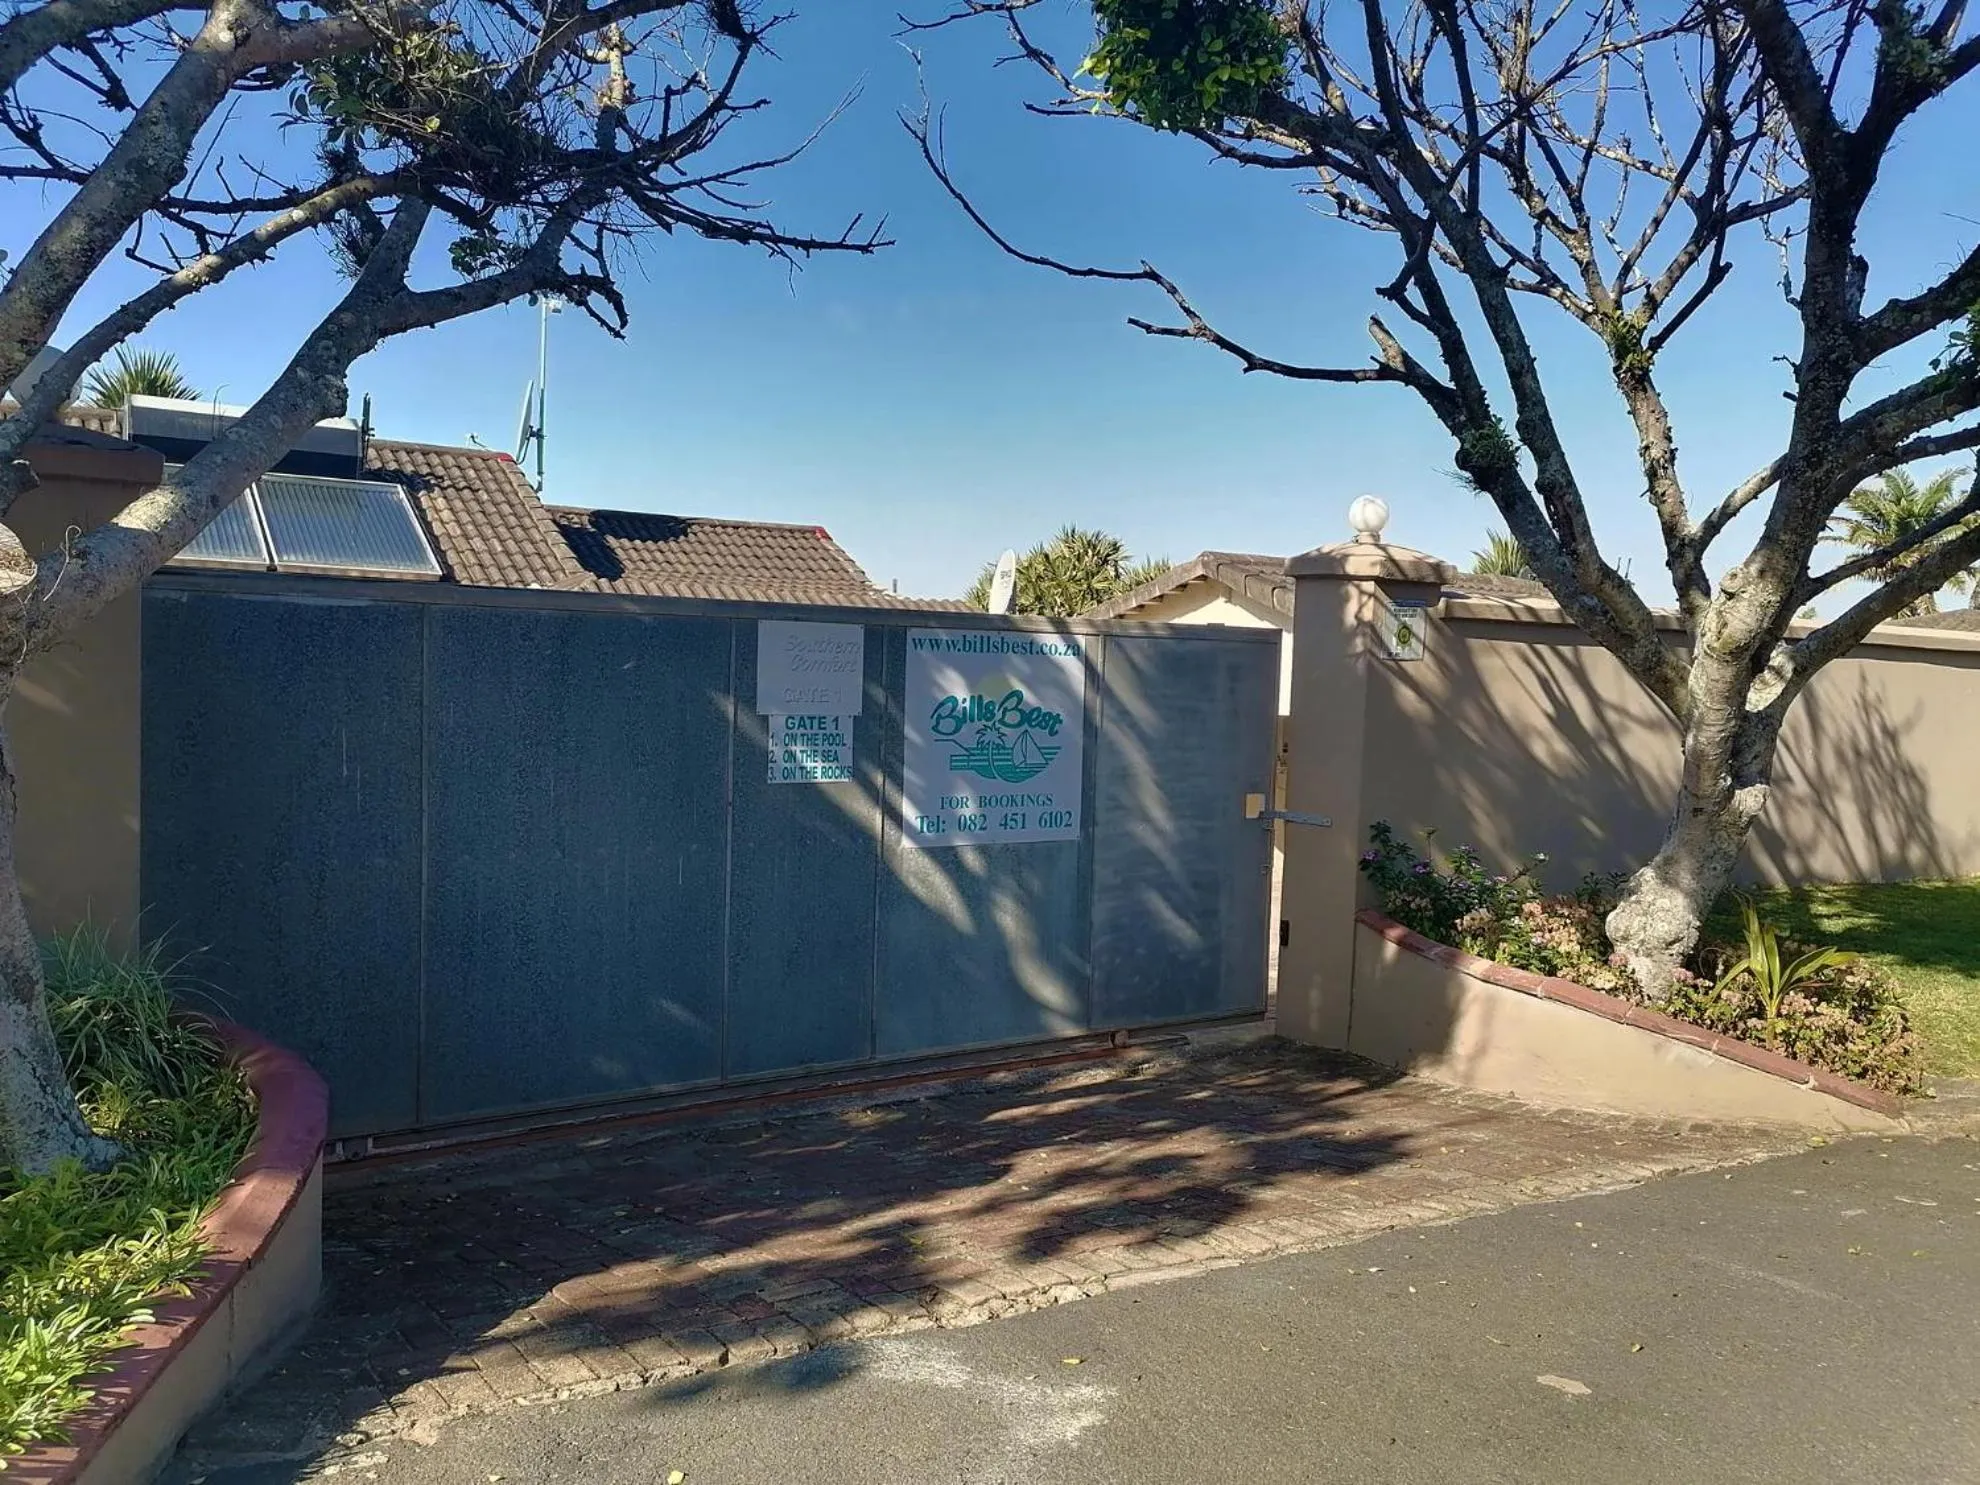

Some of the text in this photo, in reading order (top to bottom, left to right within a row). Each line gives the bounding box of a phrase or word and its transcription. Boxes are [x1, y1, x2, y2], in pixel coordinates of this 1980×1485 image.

[912, 634, 1081, 656] www.billsbest.co.za
[784, 687, 830, 703] GATE
[931, 689, 1064, 737] Bills Best
[785, 716, 839, 730] GATE 1
[770, 732, 847, 747] 1. ON THE POOL
[769, 750, 839, 764] 2. ON THE SEA
[768, 766, 853, 781] 3. ON THE ROCKS
[940, 794, 1054, 810] FOR BOOKINGS
[915, 810, 1073, 834] Tel: 082 451 6102
